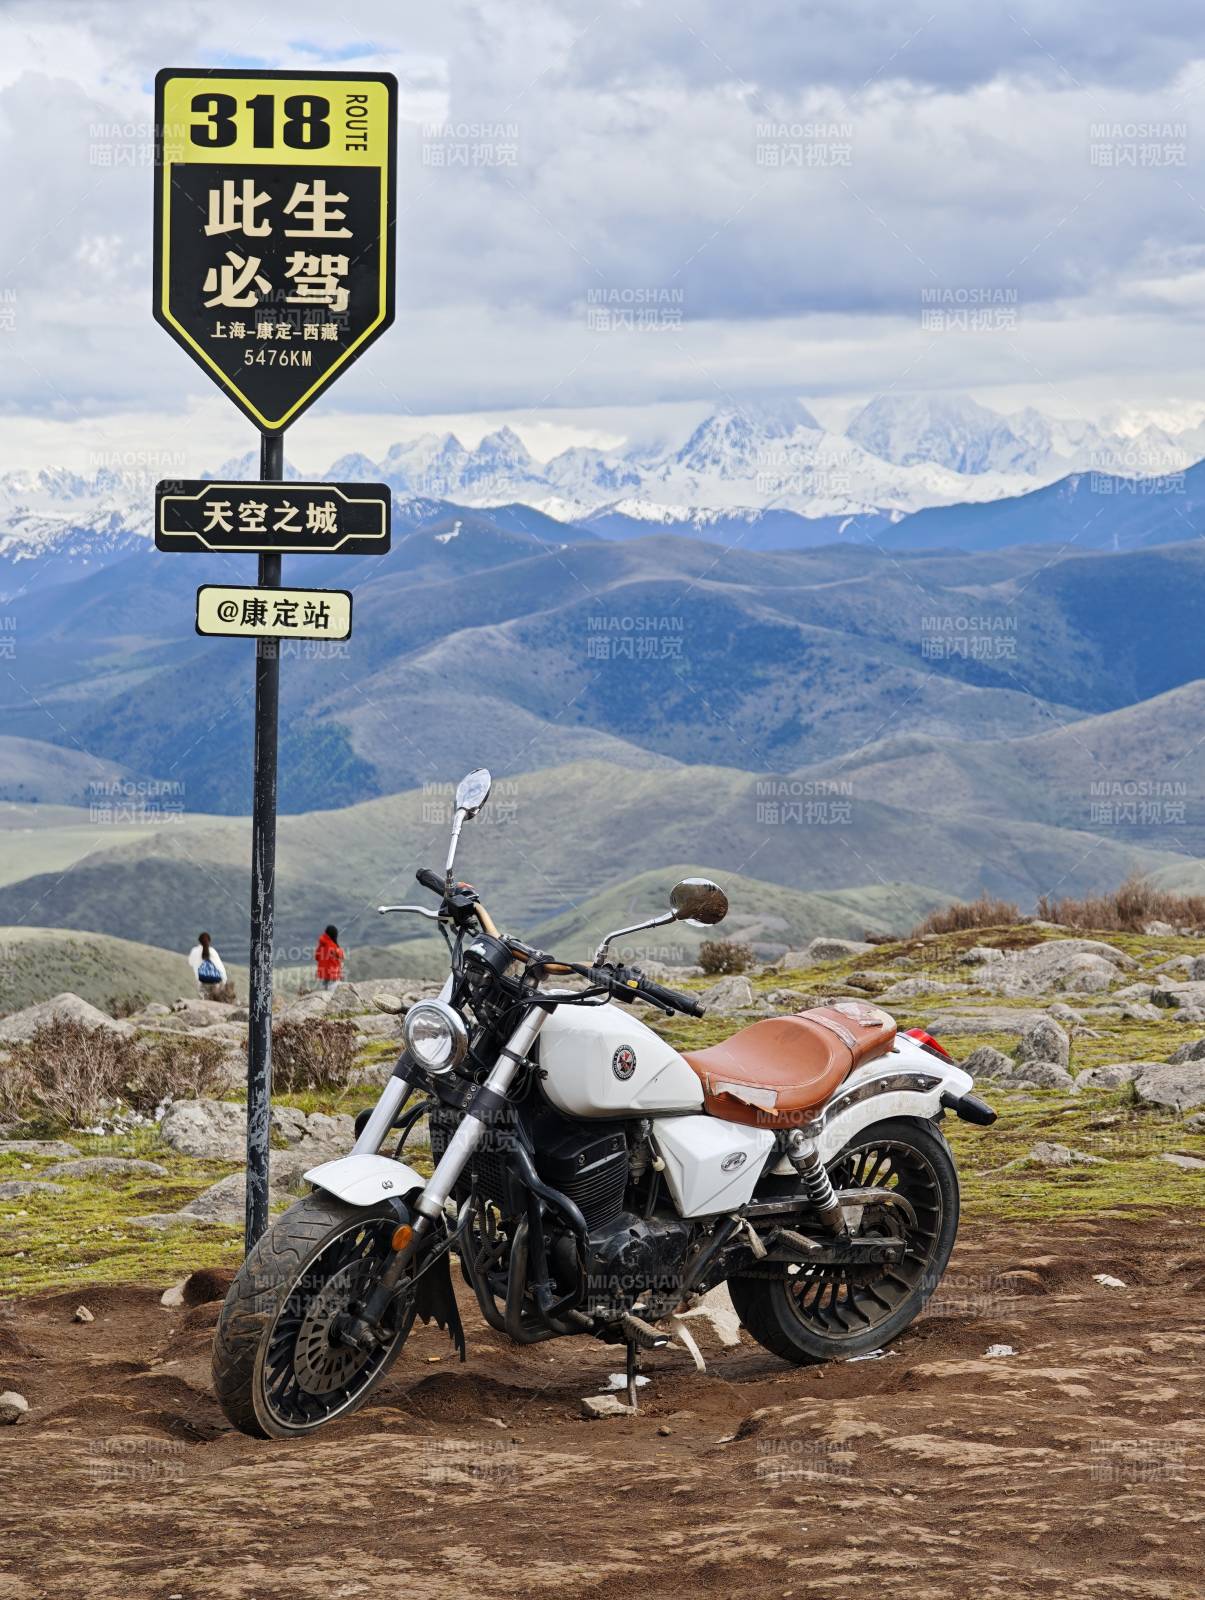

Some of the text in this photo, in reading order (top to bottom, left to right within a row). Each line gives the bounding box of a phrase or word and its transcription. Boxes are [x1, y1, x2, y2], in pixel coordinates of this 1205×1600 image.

[190, 93, 330, 150] 318
[345, 94, 368, 151] ROUTE
[204, 179, 354, 239] 此生
[203, 251, 350, 311] 必驾
[210, 321, 338, 341] 上海-康定-西藏
[244, 350, 312, 367] 5476KM
[203, 500, 338, 534] 天空之城
[217, 598, 331, 629] @康定站
